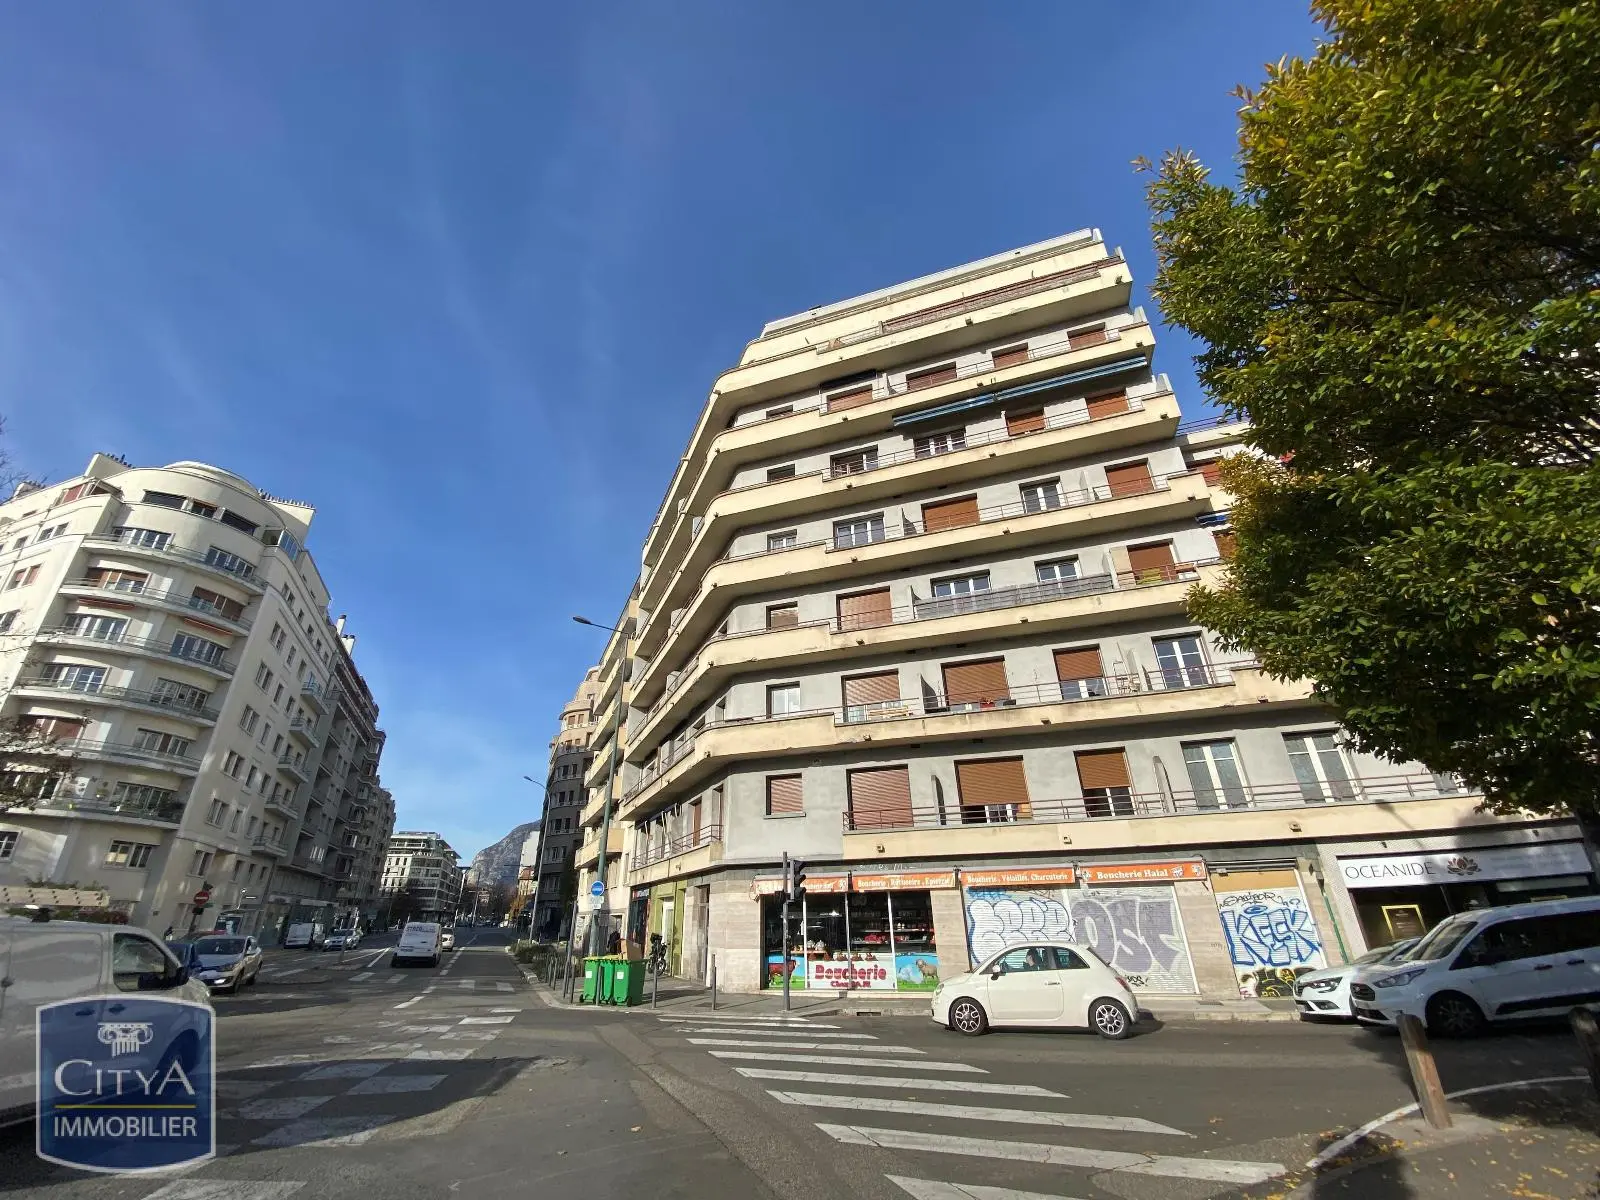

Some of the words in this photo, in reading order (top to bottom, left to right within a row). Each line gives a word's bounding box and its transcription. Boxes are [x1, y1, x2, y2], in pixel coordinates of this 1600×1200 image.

[1096, 871, 1142, 880] Boucherie
[1143, 868, 1169, 878] Halal
[1344, 861, 1437, 879] OCEANIDE
[815, 963, 887, 981] Boucherie
